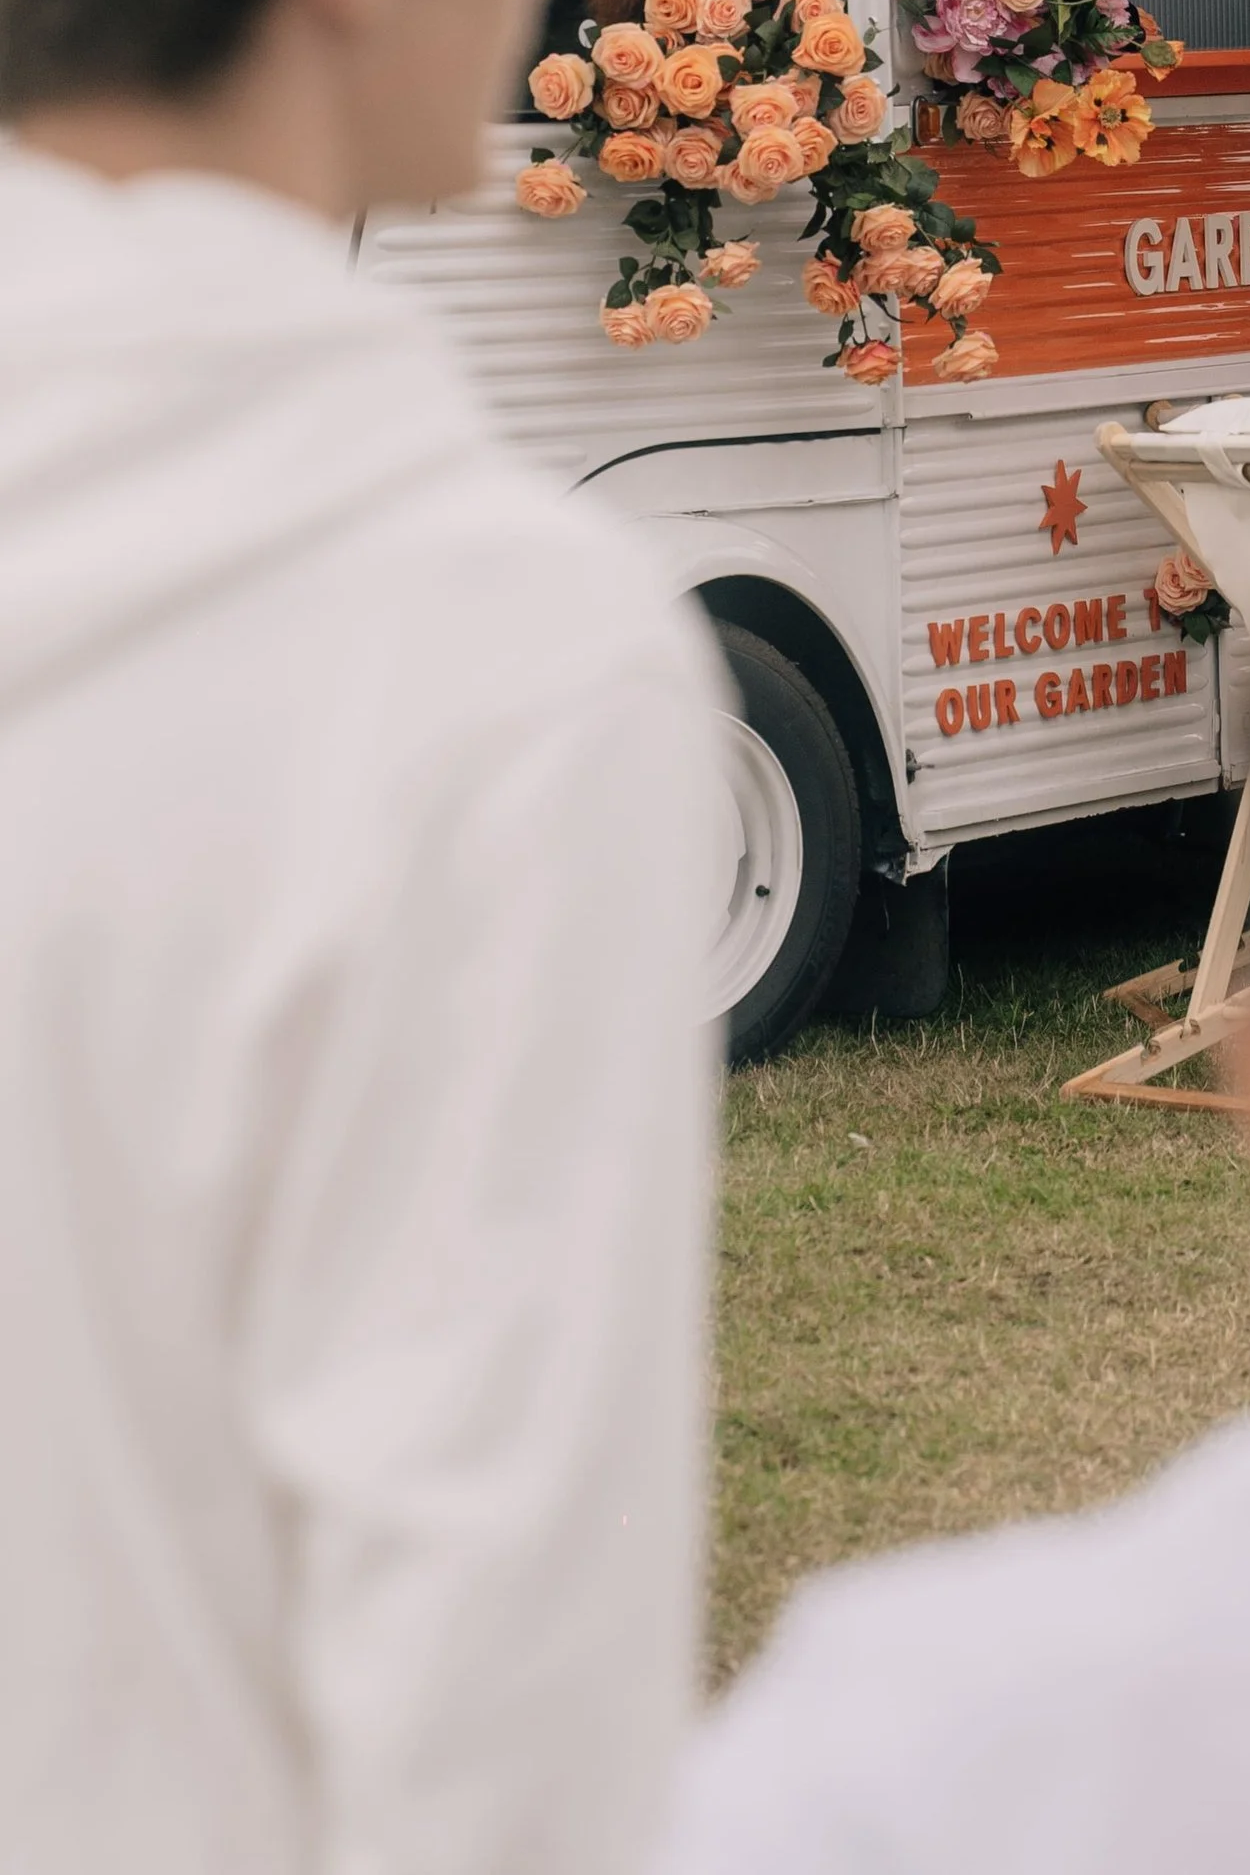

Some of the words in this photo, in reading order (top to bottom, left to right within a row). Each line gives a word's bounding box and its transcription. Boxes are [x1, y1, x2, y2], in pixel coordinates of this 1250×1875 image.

[927, 594, 1128, 668] WELCOME
[1144, 588, 1162, 631] T
[935, 679, 1020, 737] OUR
[1034, 650, 1187, 719] GARDEN
